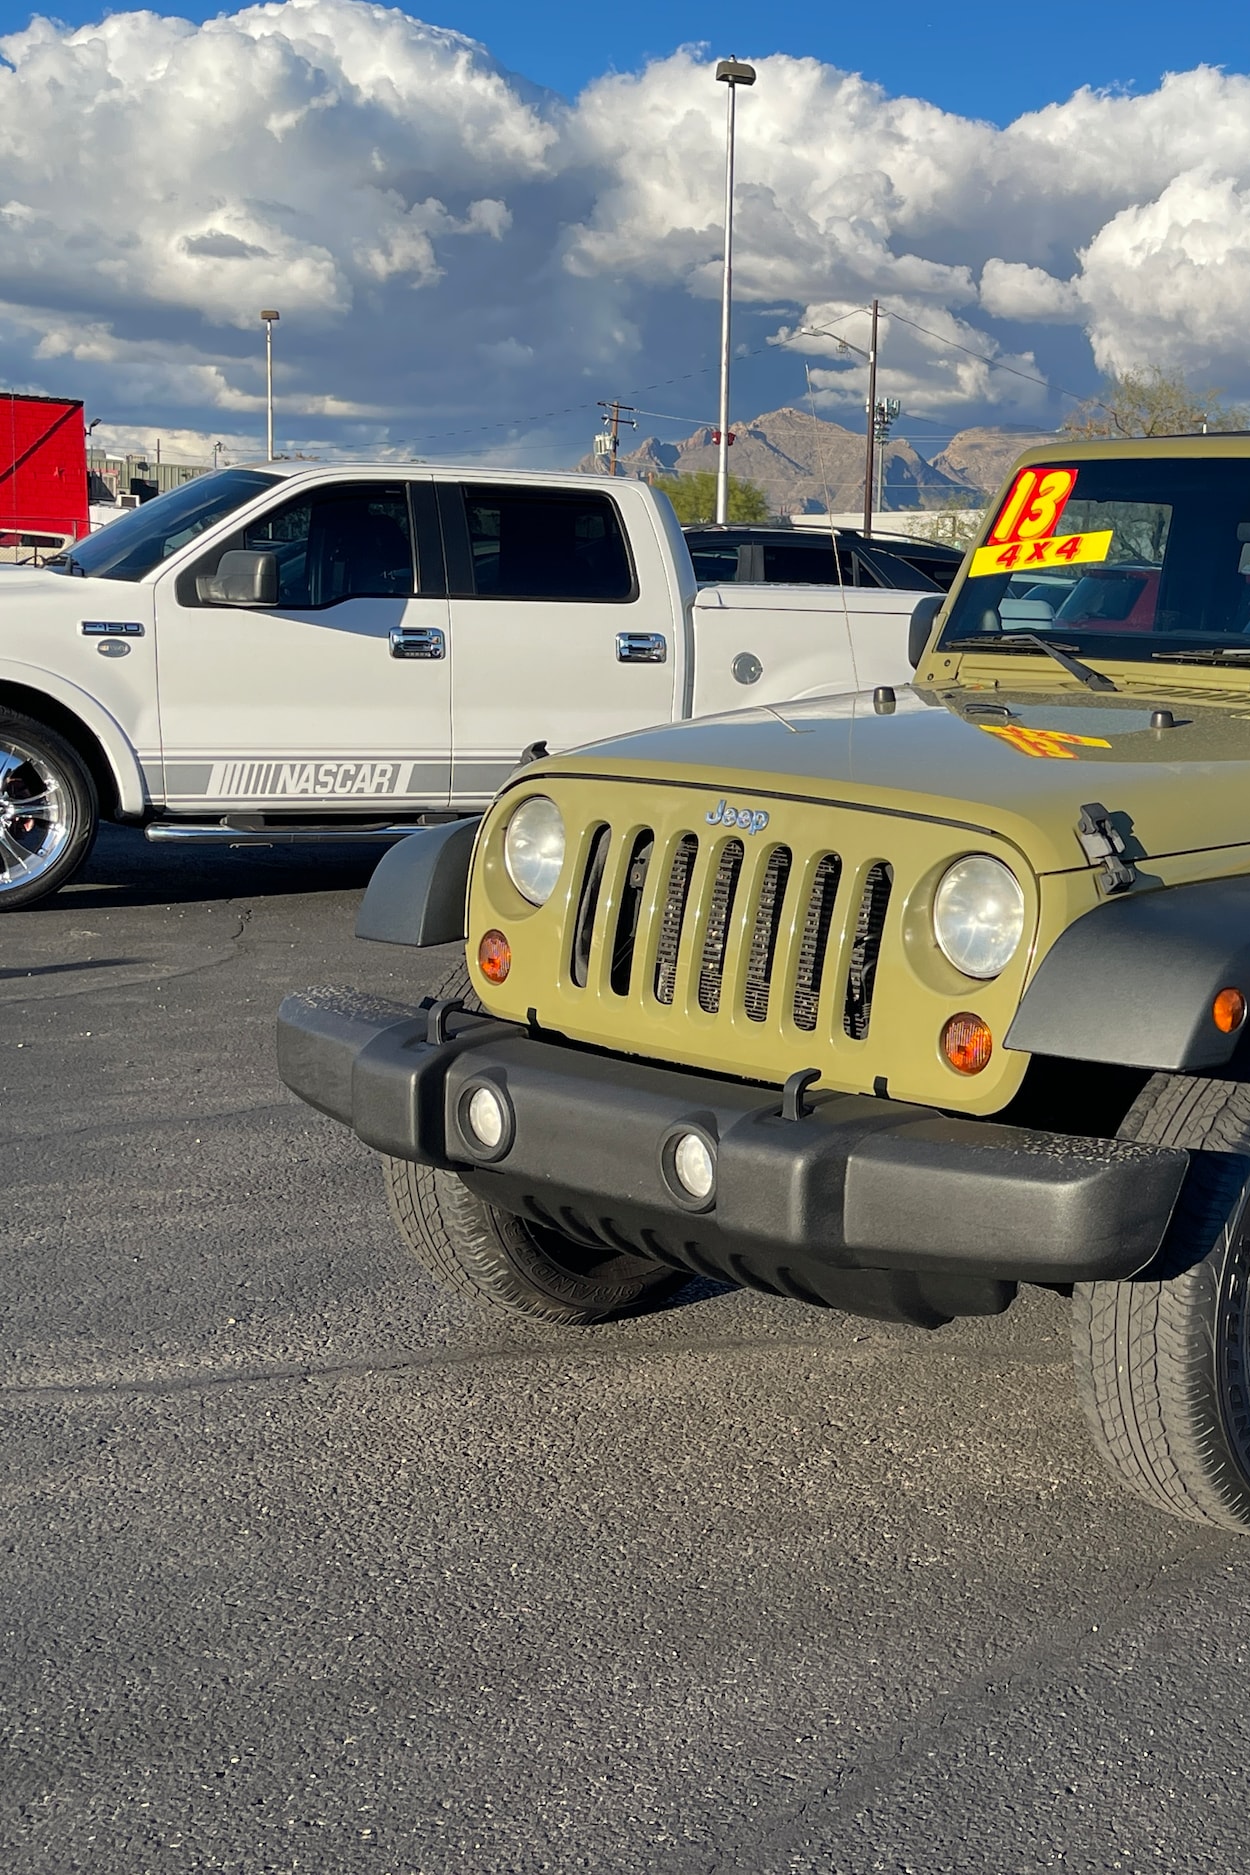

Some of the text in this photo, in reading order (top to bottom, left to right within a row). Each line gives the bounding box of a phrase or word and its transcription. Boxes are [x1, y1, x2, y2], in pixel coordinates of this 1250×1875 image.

[994, 471, 1072, 541] 13
[275, 763, 393, 794] NASCAR
[705, 799, 769, 836] Jeep
